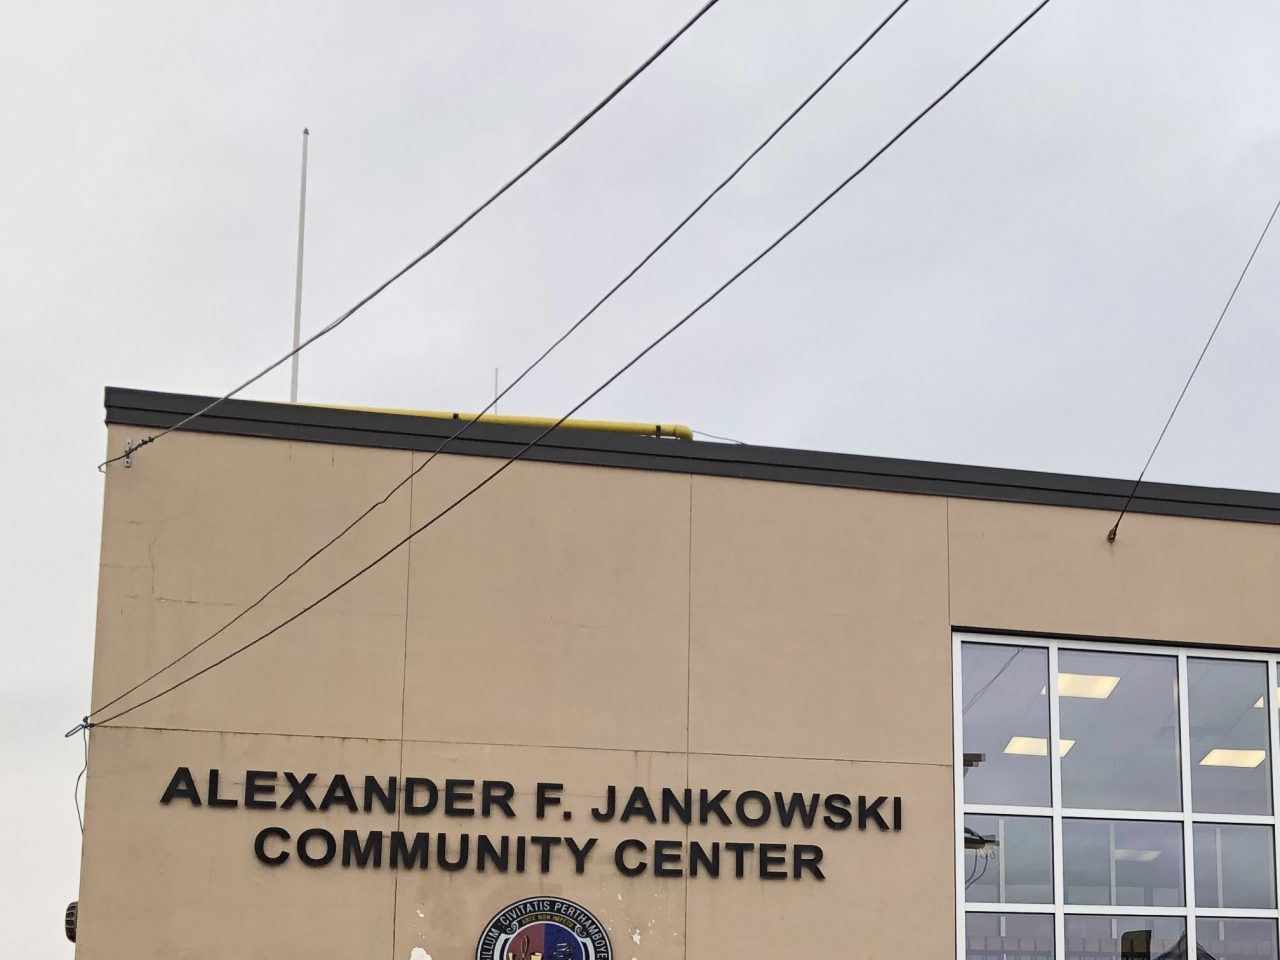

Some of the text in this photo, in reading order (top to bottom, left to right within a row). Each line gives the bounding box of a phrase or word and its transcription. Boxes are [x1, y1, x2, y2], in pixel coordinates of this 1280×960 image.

[160, 767, 902, 831] ALEXANDER F. JANKOWSKI
[254, 826, 826, 881] COMMUNITY CENTER
[500, 901, 551, 926] CIVITATIS
